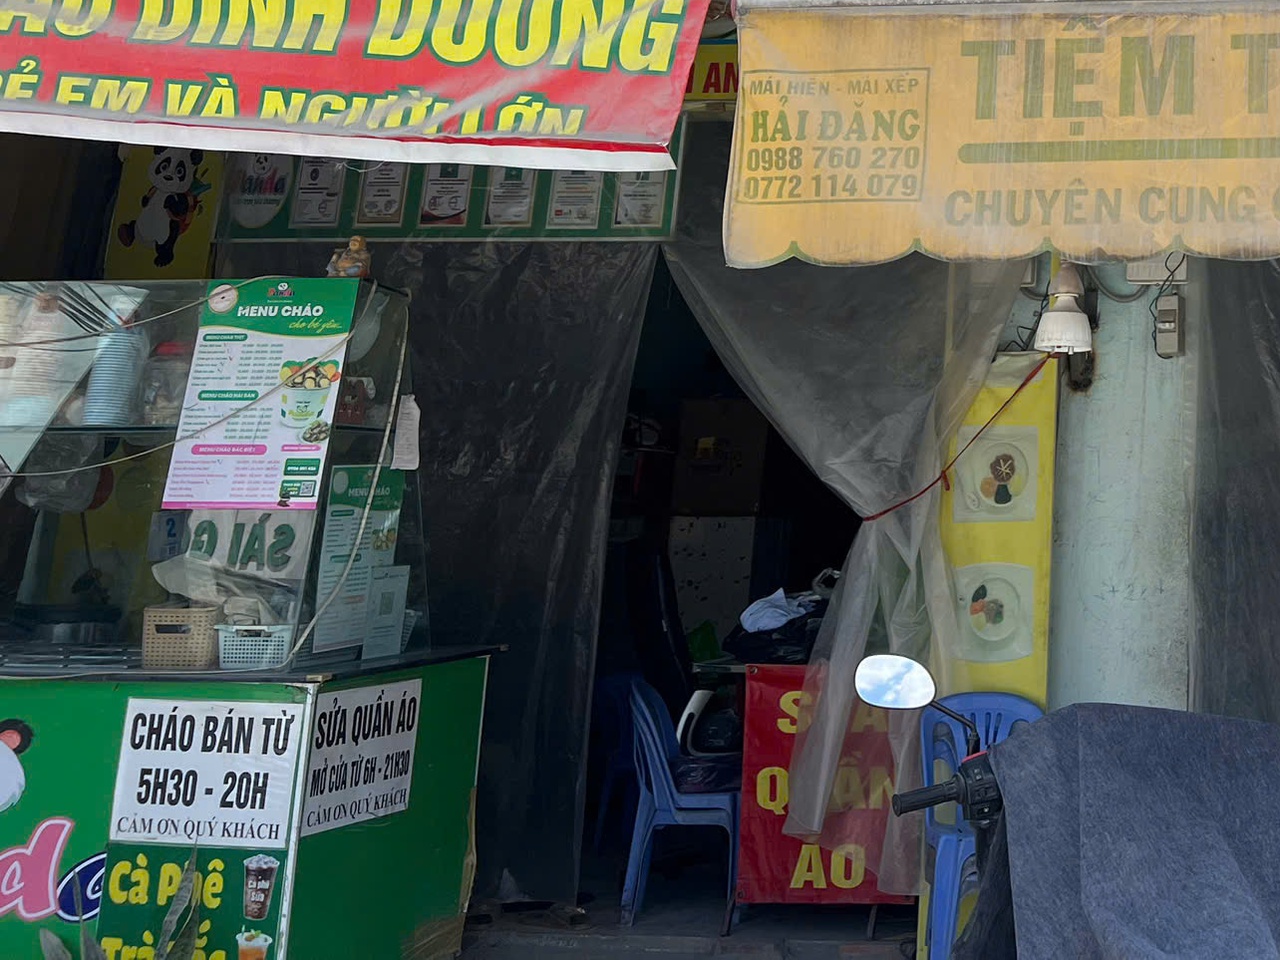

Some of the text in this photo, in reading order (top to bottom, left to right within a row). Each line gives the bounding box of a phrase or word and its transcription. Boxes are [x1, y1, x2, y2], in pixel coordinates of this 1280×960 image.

[961, 11, 1195, 136] TIỆM
[750, 96, 809, 143] HẢI
[746, 146, 921, 172] 0988 760 270
[744, 174, 919, 200] 0772 114 079
[945, 178, 1122, 227] CHUYÊN
[1138, 184, 1257, 224] CUNG
[237, 302, 324, 318] MENU CHÁO
[130, 707, 295, 756] CHÁO BÁN TỪ
[315, 688, 418, 750] SỬA QUẦN ÁO
[136, 767, 270, 810] 5H30 20H
[309, 749, 411, 798] MỞ CỬA TỪ 6H 21H30
[184, 816, 218, 839] QUÝ
[221, 818, 281, 841] KHÁCH
[109, 853, 150, 906] Cà
